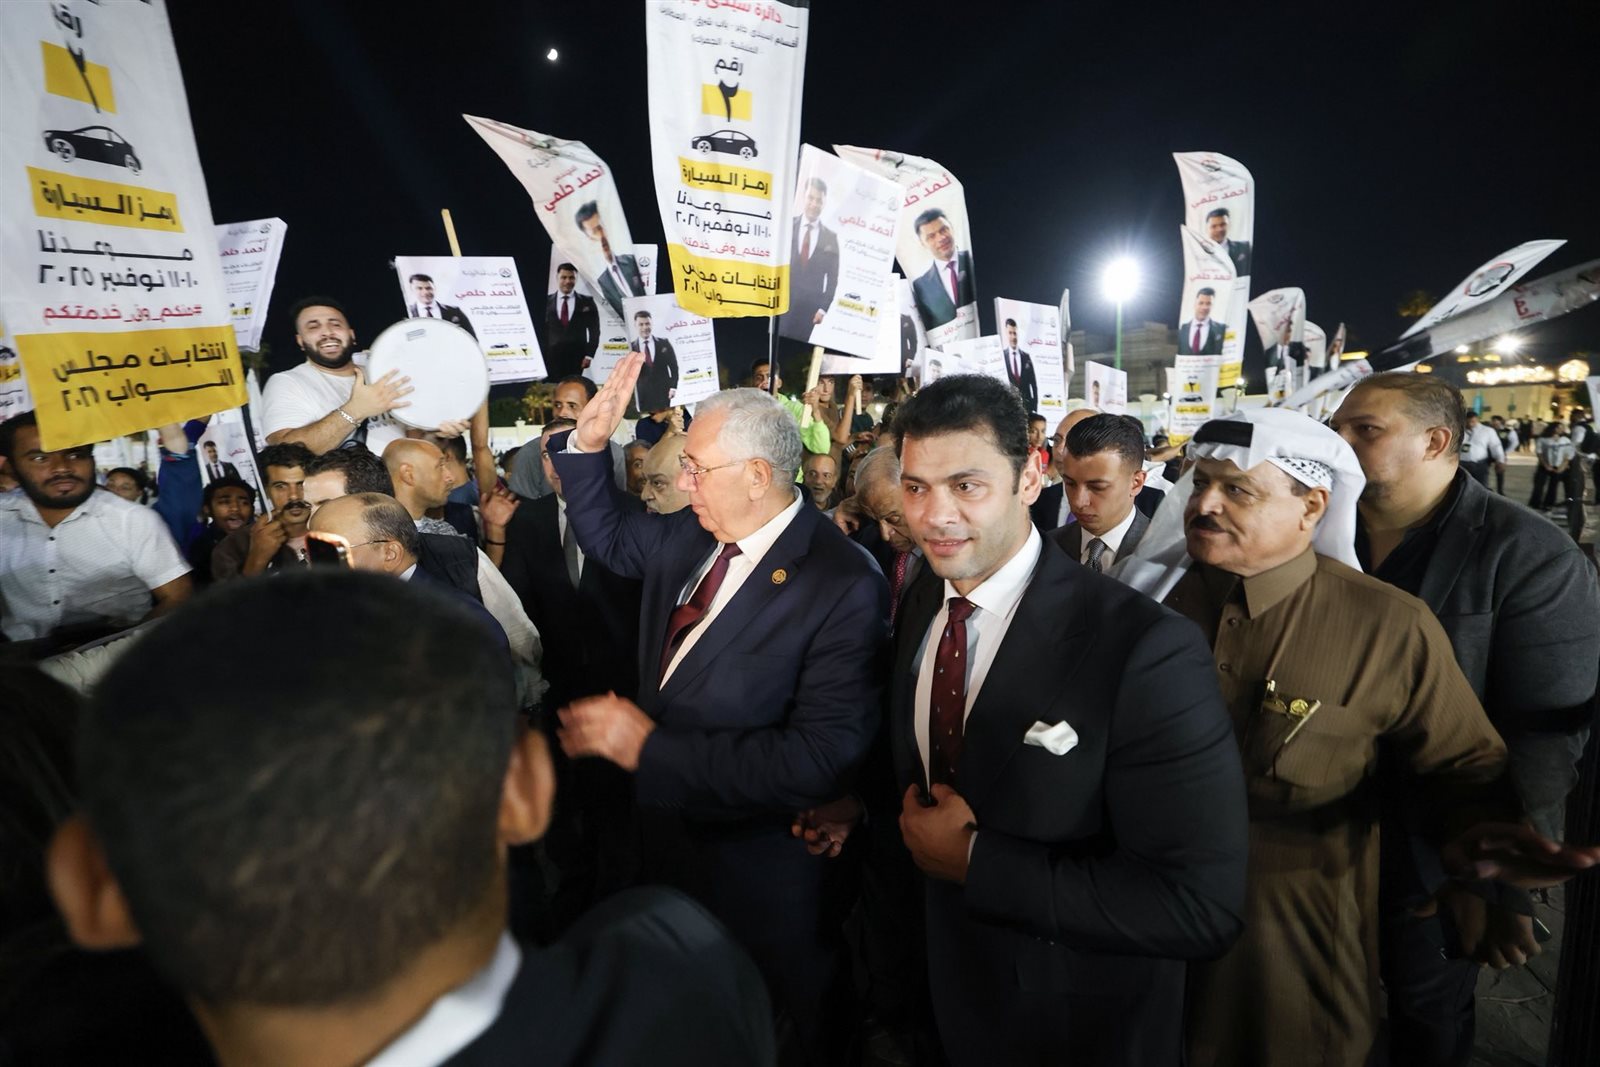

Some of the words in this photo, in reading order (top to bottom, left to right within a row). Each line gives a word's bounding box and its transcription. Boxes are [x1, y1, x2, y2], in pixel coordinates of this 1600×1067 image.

[714, 57, 743, 76] رقم
[719, 79, 739, 122] ٢
[682, 164, 738, 187] السيارة
[742, 173, 769, 195] رمز
[39, 180, 133, 215] السيارة
[138, 196, 176, 225] رمز
[545, 184, 576, 214] حلمي
[677, 190, 773, 221] موعدنا
[703, 218, 750, 236] نوفمبر
[37, 229, 194, 262] موعدنا
[101, 267, 165, 292] نوفمبر
[490, 286, 518, 297] أحمد
[721, 270, 781, 291] انتخابات
[454, 289, 487, 300] حلمي
[704, 289, 780, 310] النواب
[52, 350, 141, 383] مجلس
[149, 341, 228, 368] انتخابات
[105, 368, 236, 406] النواب
